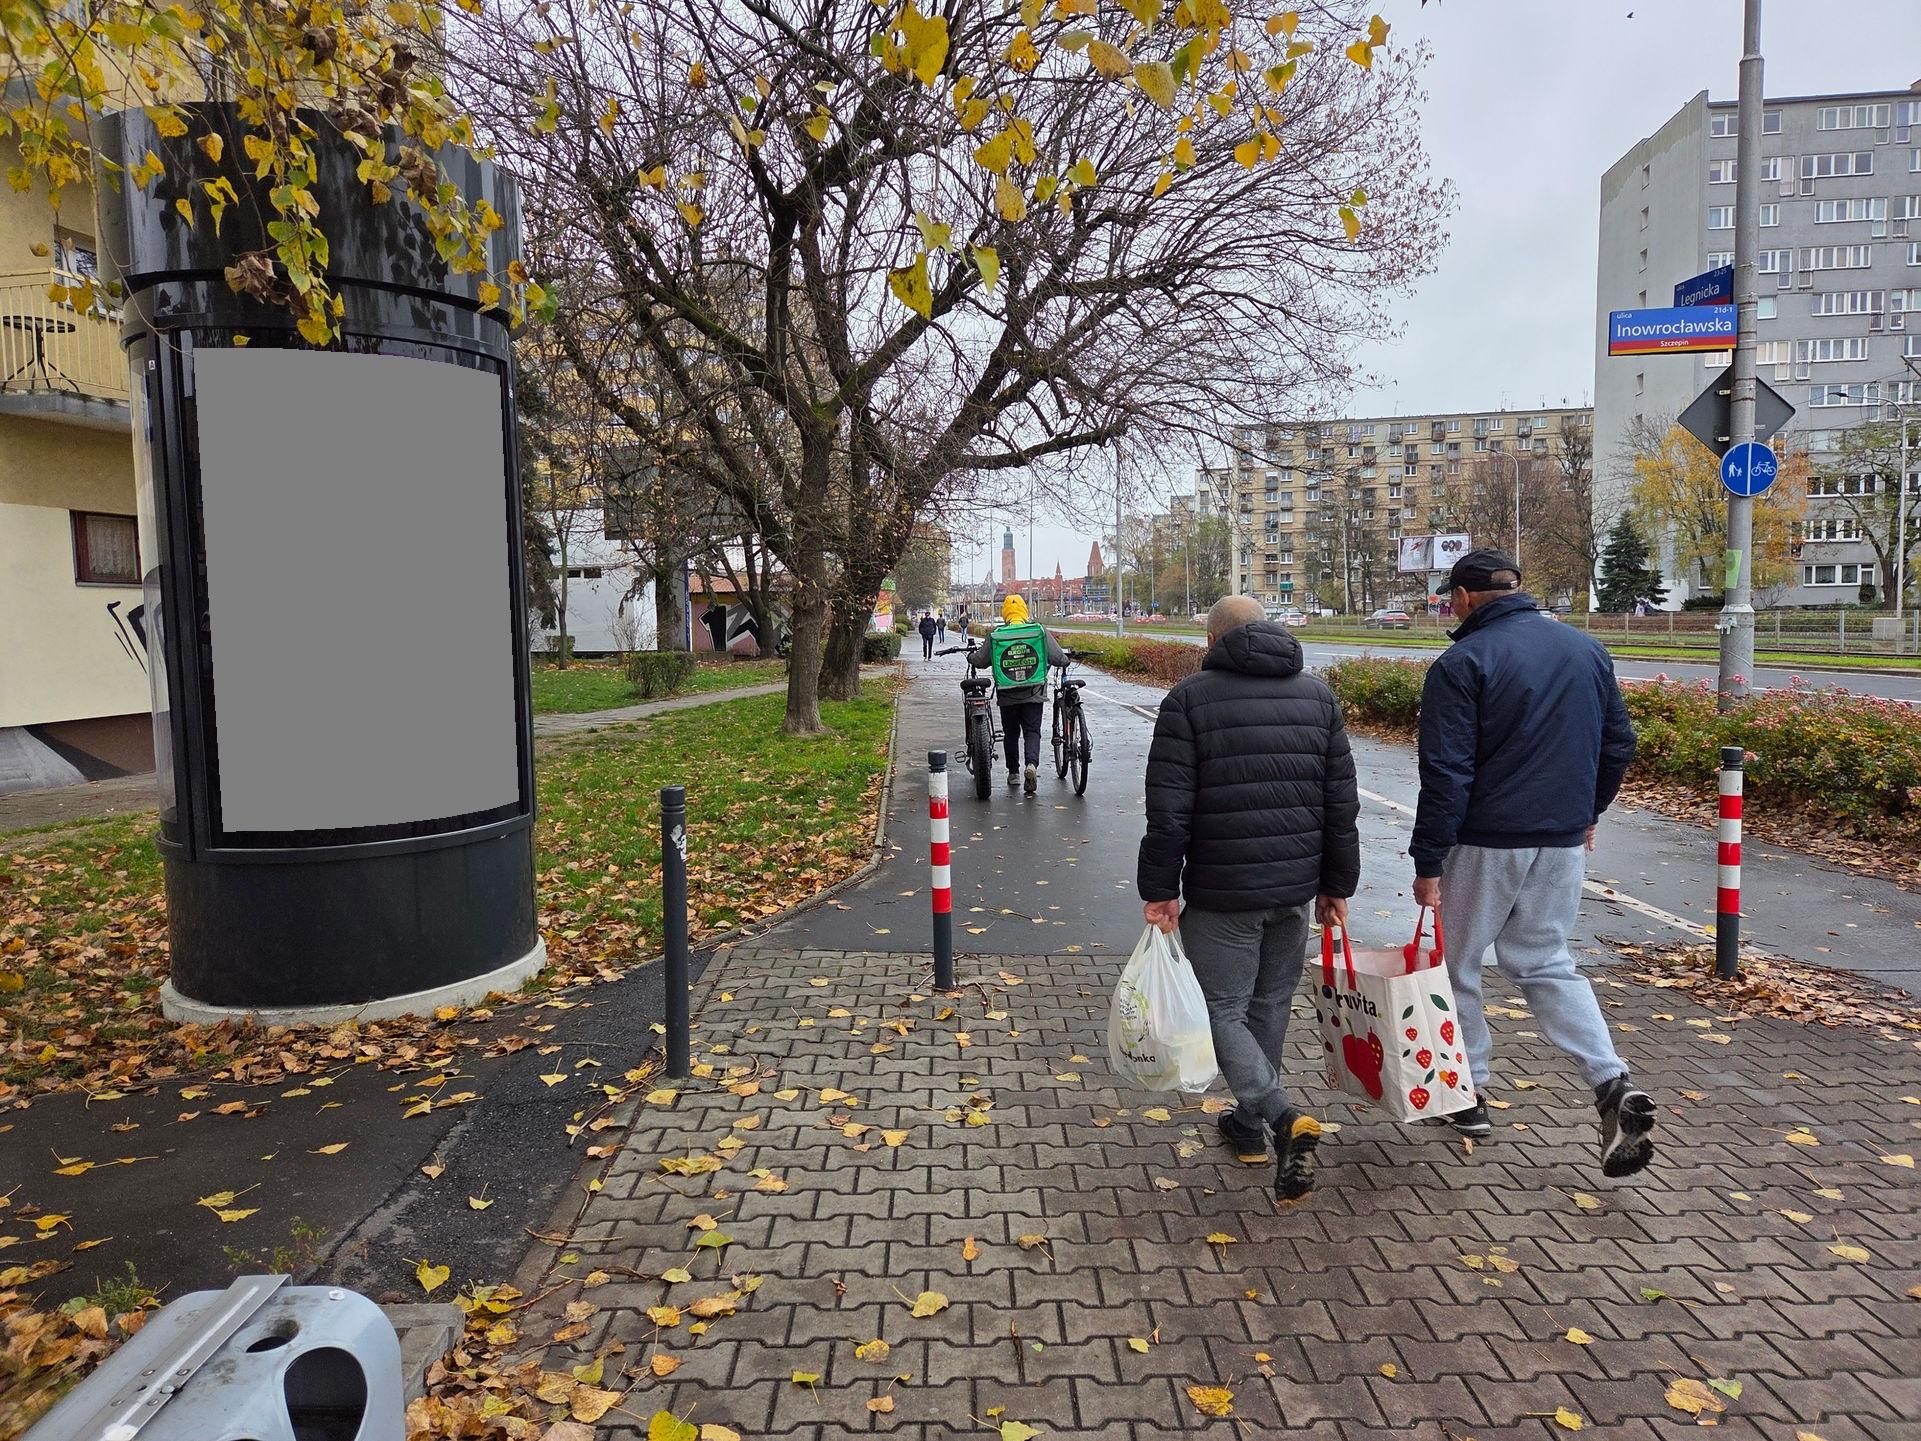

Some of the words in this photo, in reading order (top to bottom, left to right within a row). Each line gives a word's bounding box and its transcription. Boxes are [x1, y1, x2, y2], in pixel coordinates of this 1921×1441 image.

[1681, 283, 1720, 306] Legnicka
[1617, 318, 1732, 337] Inowrocławska
[1660, 339, 1689, 347] Szczepin
